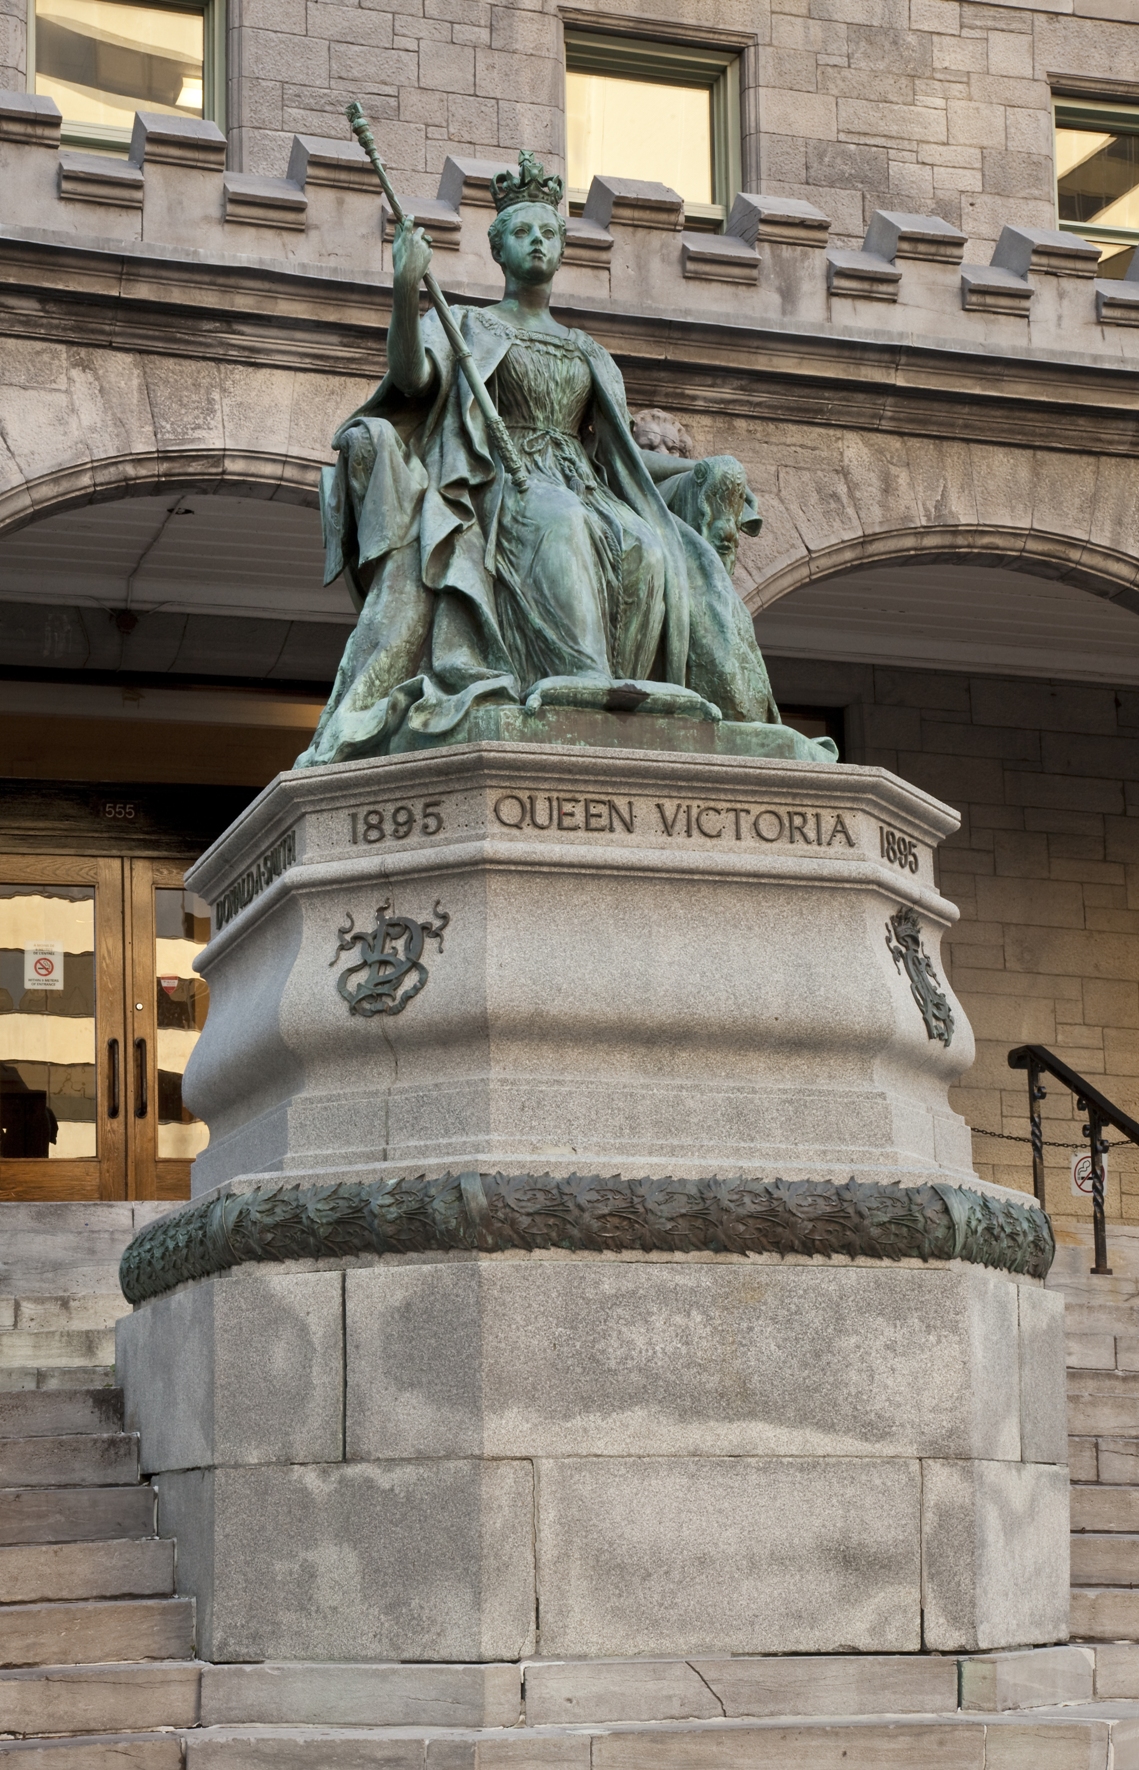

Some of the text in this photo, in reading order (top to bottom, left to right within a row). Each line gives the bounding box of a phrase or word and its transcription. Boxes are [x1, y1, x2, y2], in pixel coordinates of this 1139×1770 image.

[105, 803, 135, 818] 555
[351, 800, 444, 844] 1895
[494, 795, 856, 847] QUEEN VICTORIA
[880, 826, 919, 874] 1895
